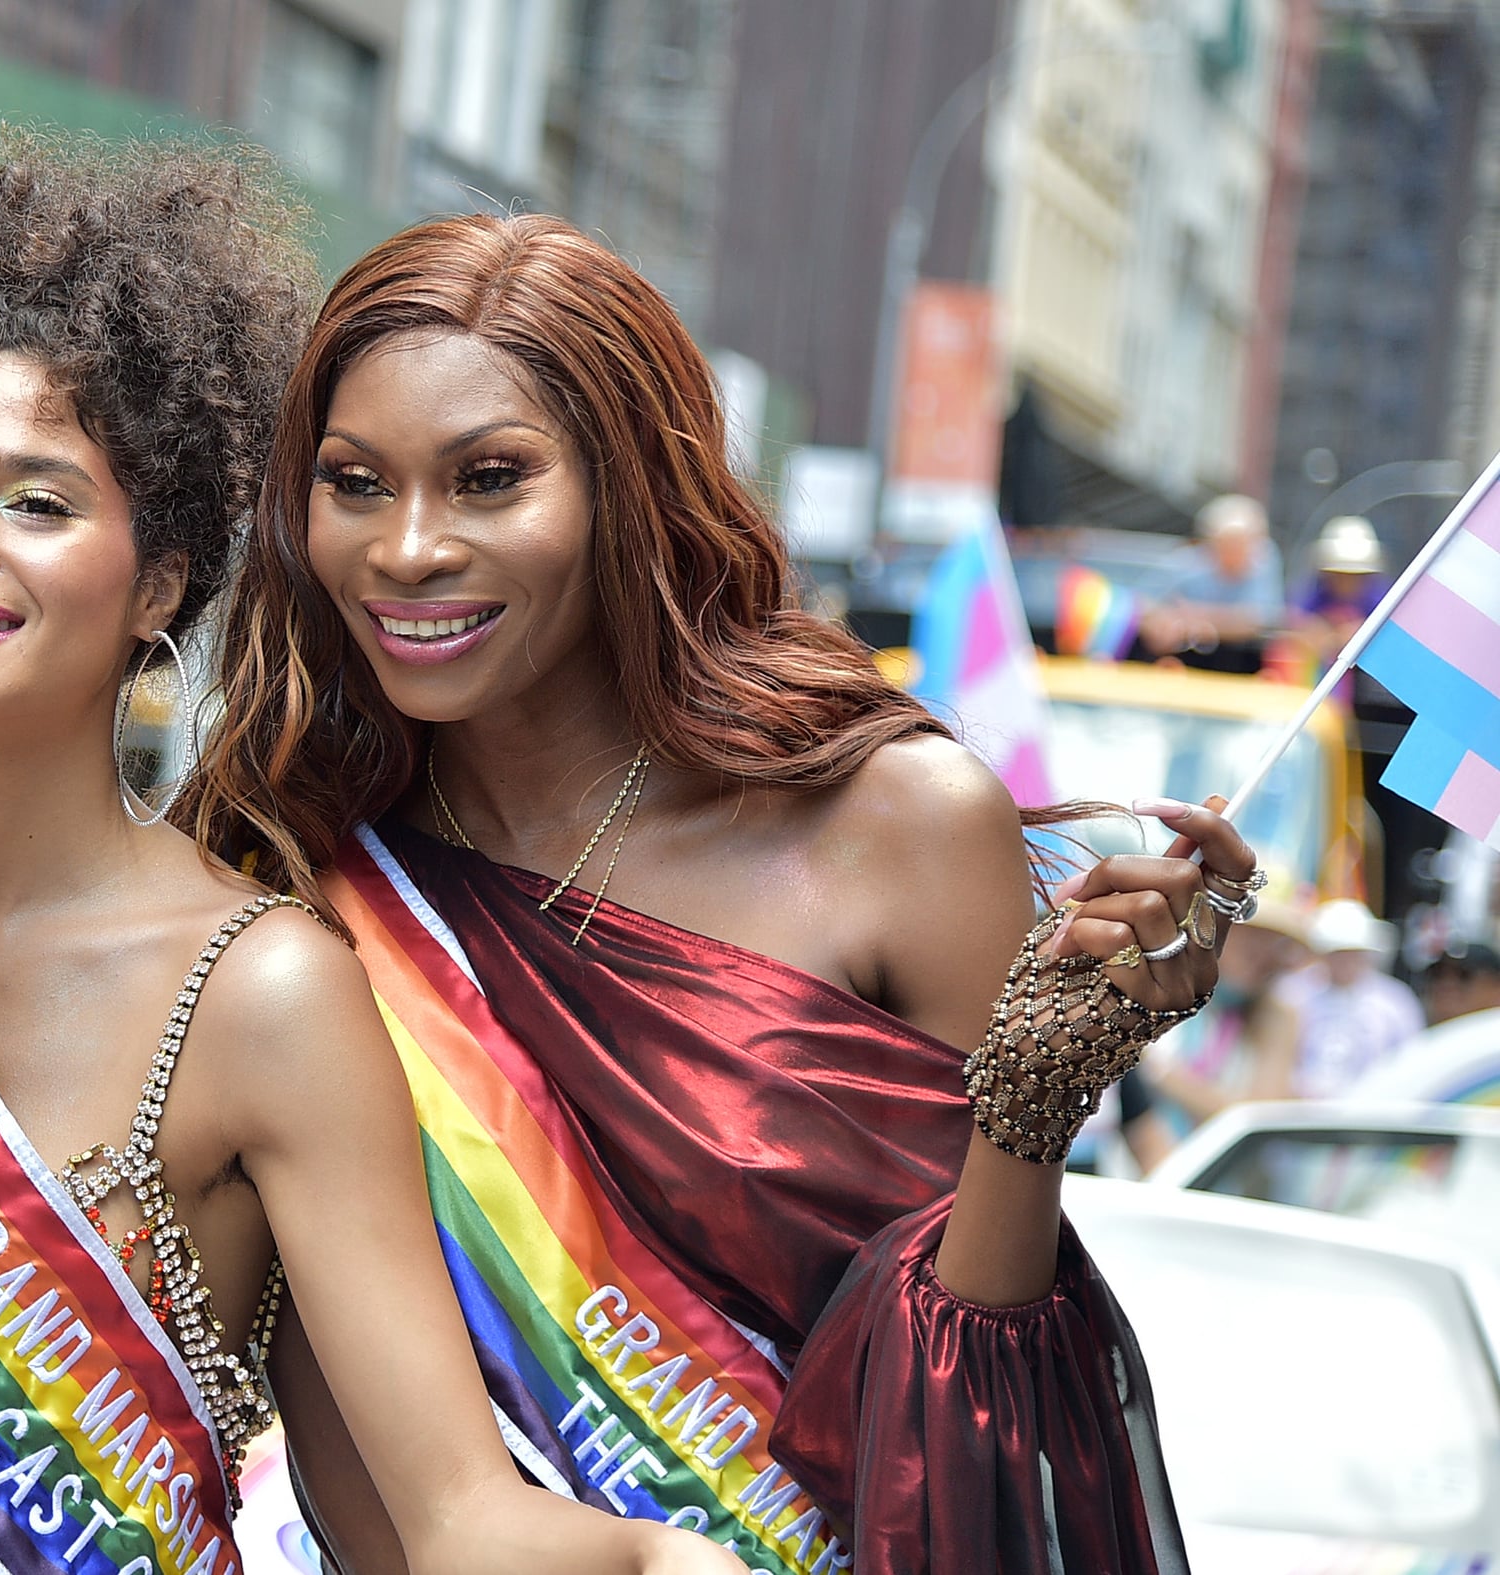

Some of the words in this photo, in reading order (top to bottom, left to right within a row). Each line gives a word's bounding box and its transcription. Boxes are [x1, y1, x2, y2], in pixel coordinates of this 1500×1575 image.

[557, 1380, 669, 1517] THE
[575, 1284, 759, 1470] GRAND
[72, 1367, 236, 1575] MARSHA
